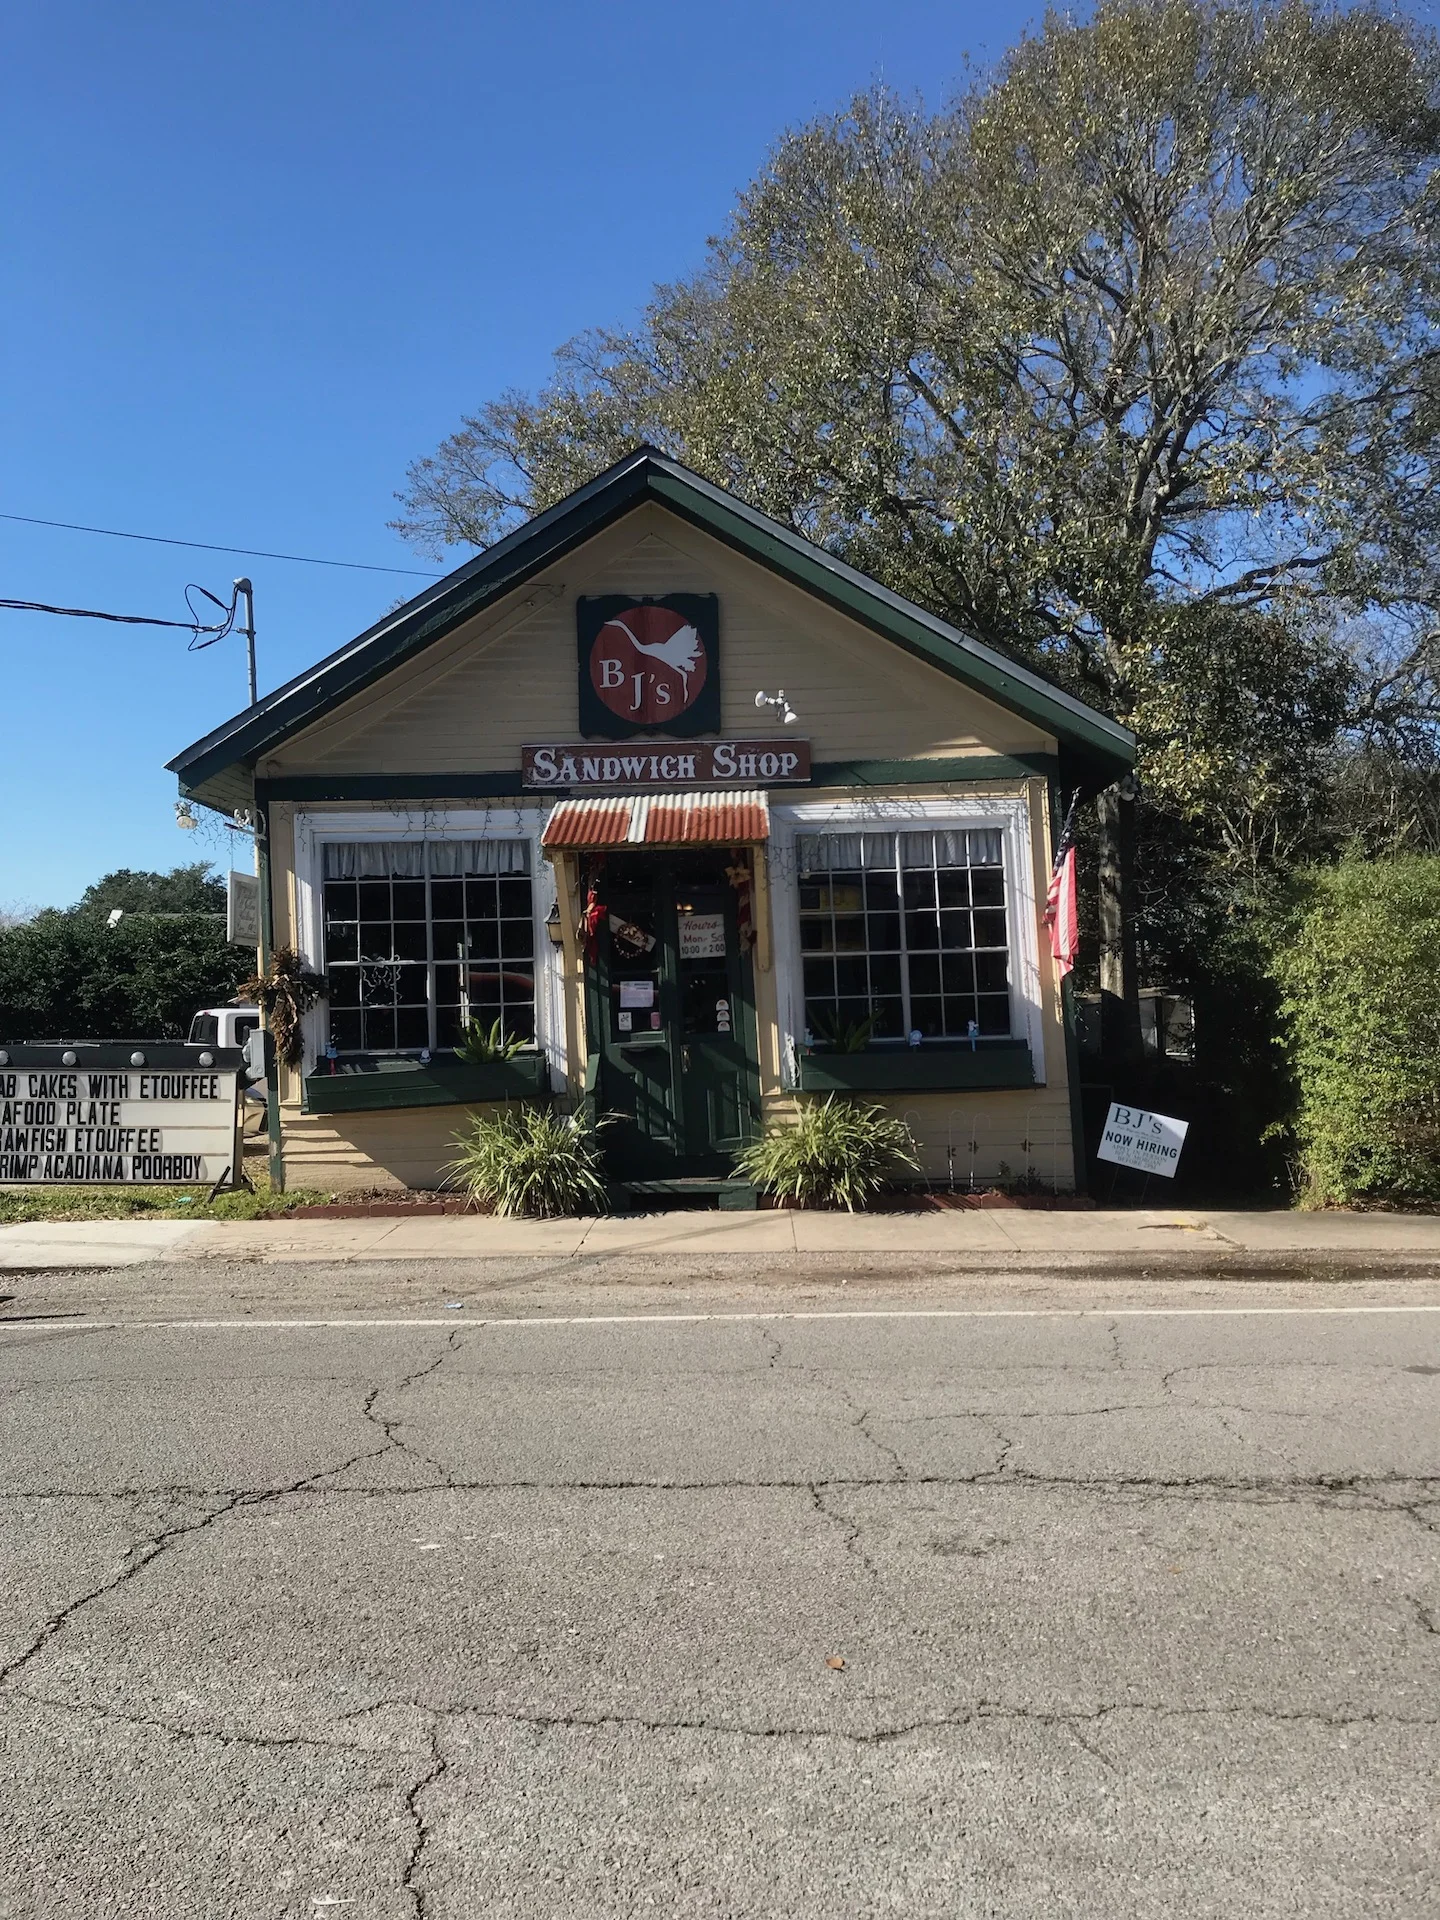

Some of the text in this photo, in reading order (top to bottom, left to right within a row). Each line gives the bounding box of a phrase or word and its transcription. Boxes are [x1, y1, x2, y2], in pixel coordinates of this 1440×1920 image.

[600, 659, 670, 711] BJ's
[532, 744, 799, 782] SANDWICH SHOP
[683, 920, 720, 930] Hours
[28, 1074, 77, 1098] CAKES
[88, 1074, 128, 1098] WITH
[140, 1075, 218, 1099] ETOUFFEE
[2, 1101, 120, 1125] AFOOD PLATE
[1113, 1107, 1163, 1135] BJ's
[0, 1128, 160, 1153] AWFISH ETOUFFEE
[1105, 1130, 1133, 1147] NOW
[1136, 1139, 1178, 1159] HIRING
[44, 1155, 123, 1180] ACADIANA
